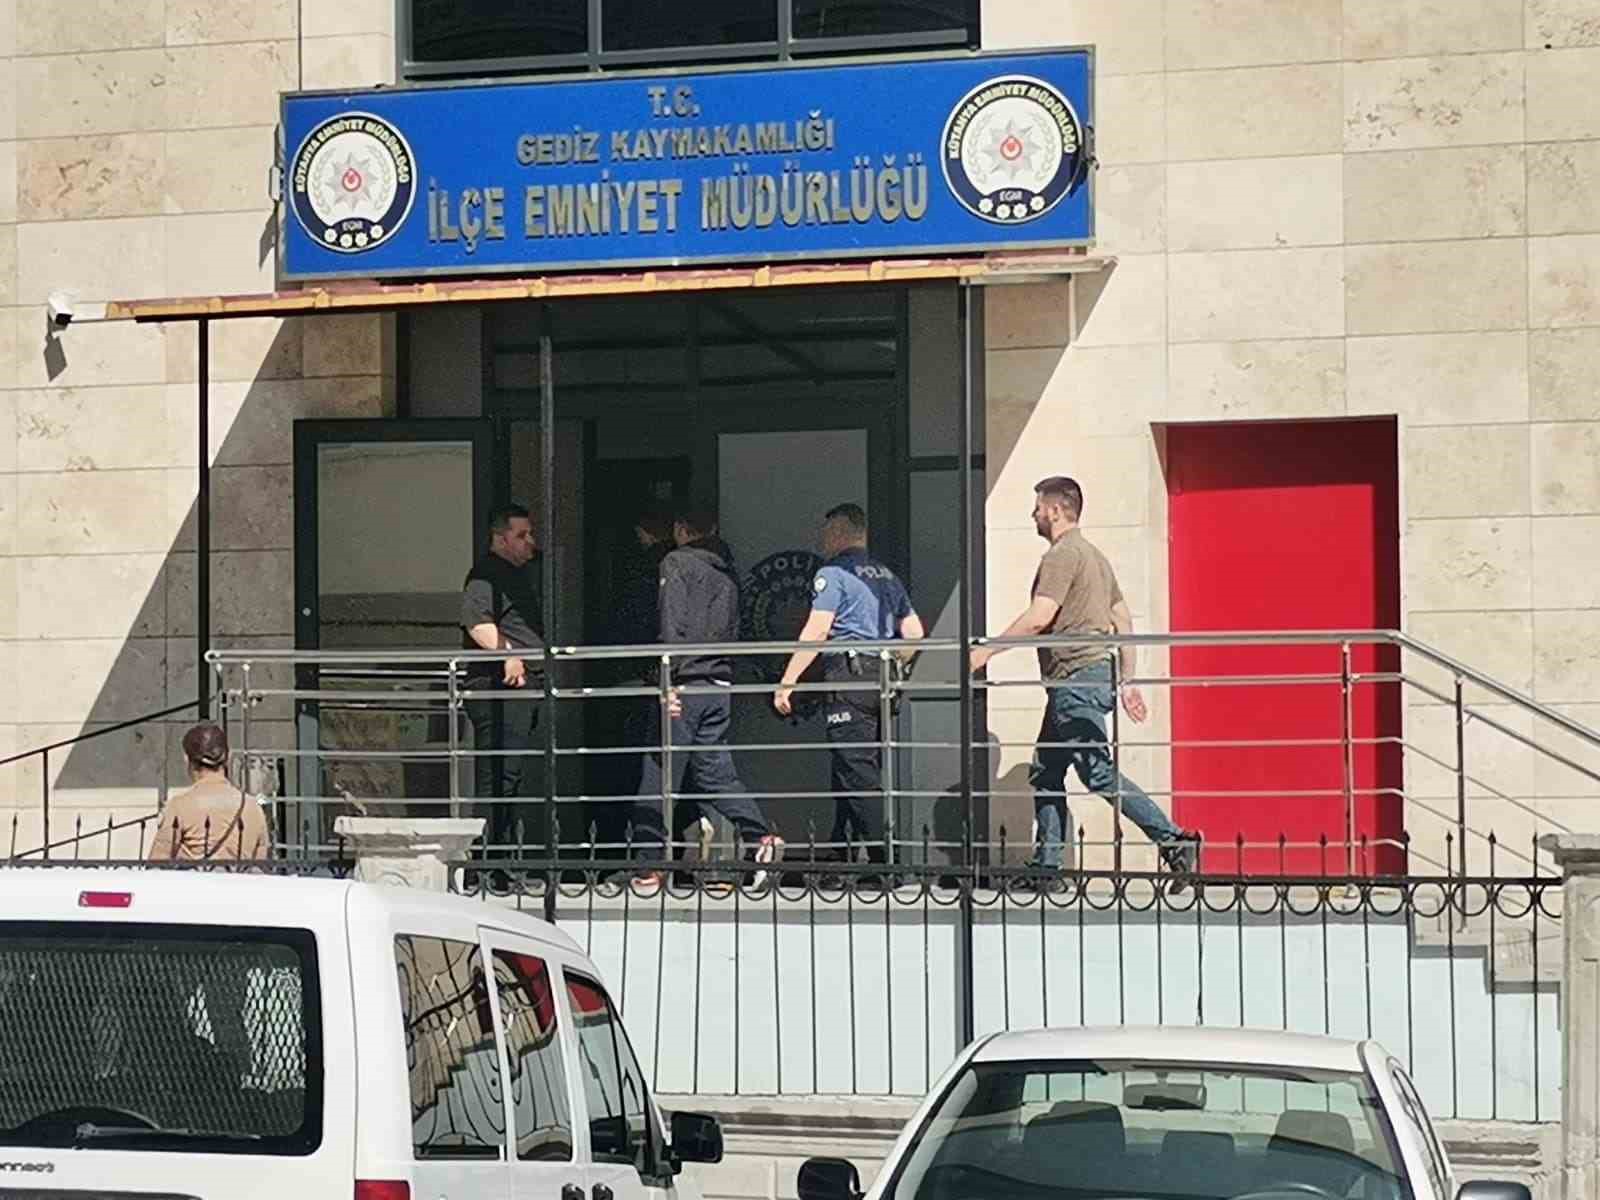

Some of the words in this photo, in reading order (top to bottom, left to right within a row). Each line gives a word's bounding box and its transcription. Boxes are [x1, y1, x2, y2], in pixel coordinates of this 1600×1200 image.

[648, 86, 700, 117] T.C.
[517, 125, 599, 165] GEDİZ
[611, 109, 834, 161] KAYMAKAMLIĞI
[428, 177, 506, 253] İLÇE
[526, 169, 683, 239] EMNİYET
[702, 151, 928, 231] MÜDÜRLÜĞÜ
